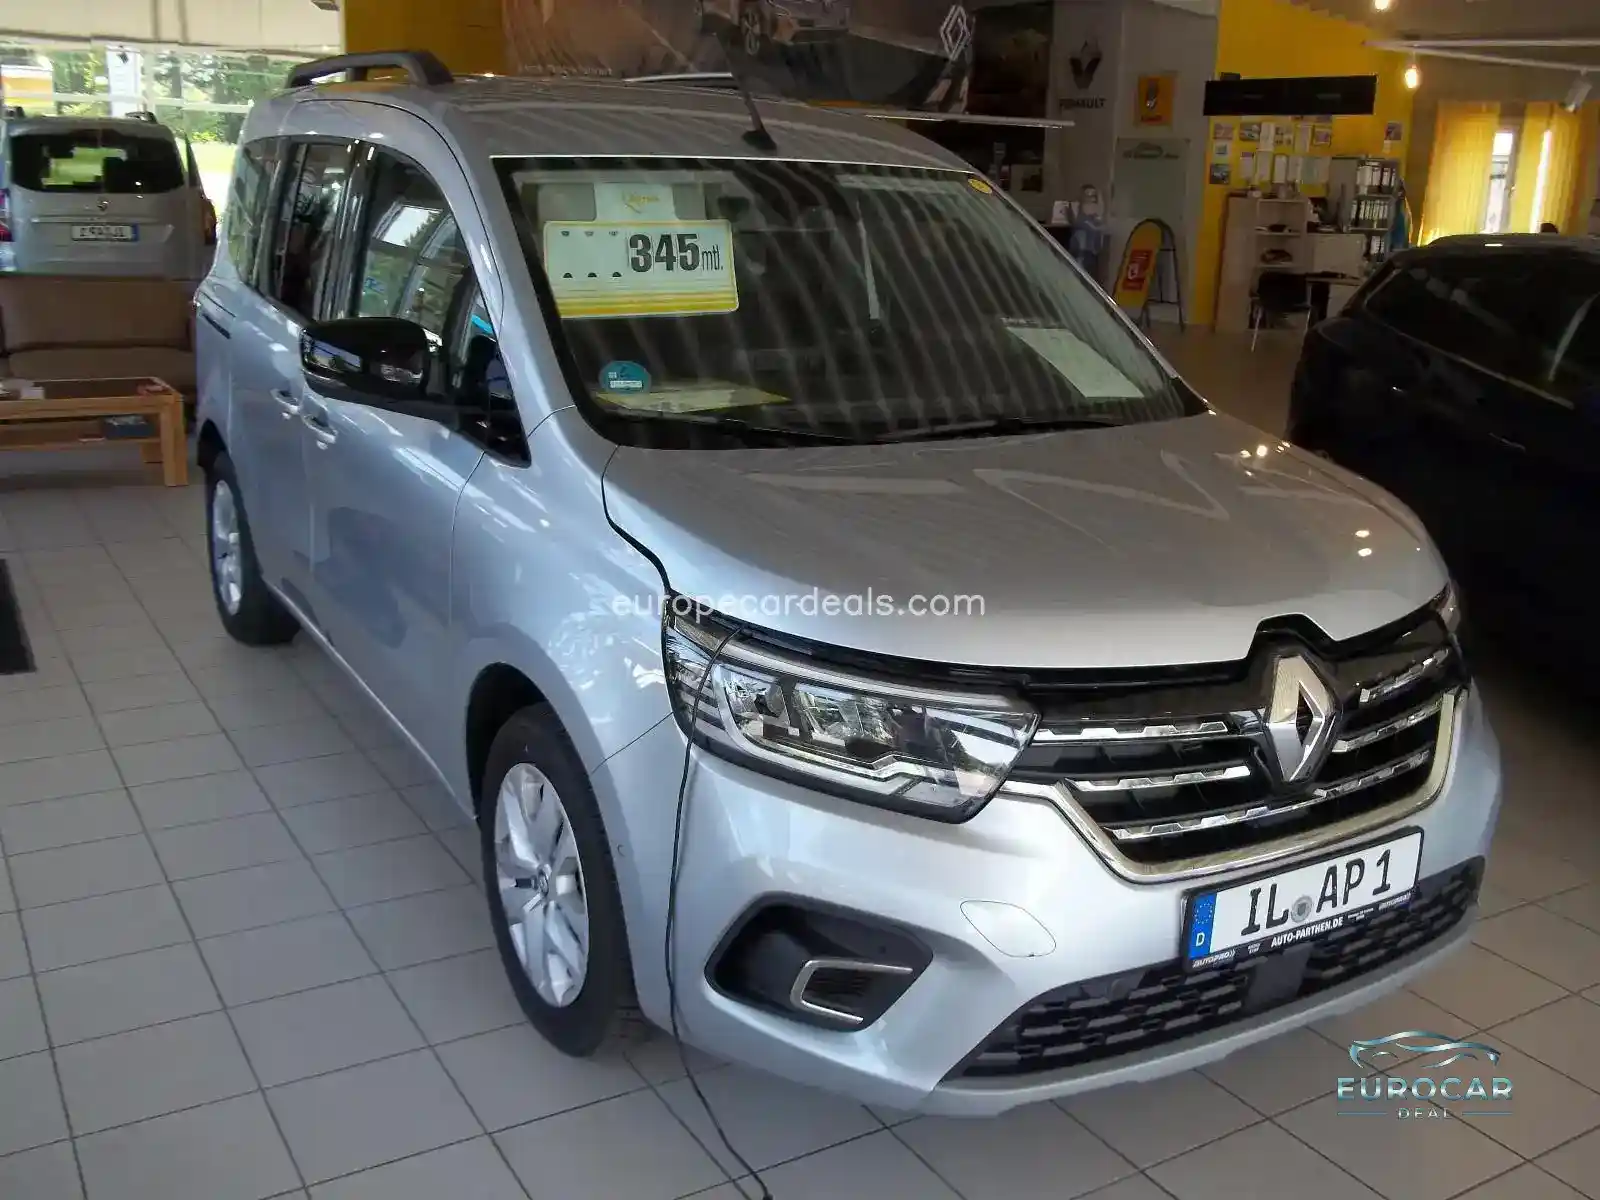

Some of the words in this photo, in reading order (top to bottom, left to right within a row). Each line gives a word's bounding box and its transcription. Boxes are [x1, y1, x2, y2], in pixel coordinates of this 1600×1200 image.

[629, 233, 700, 273] 345
[1240, 883, 1289, 936] IL
[1315, 857, 1365, 913] AP
[1372, 849, 1391, 896] 1
[1195, 932, 1205, 947] D
[1270, 916, 1344, 948] AUTO-PARTHEN.DE
